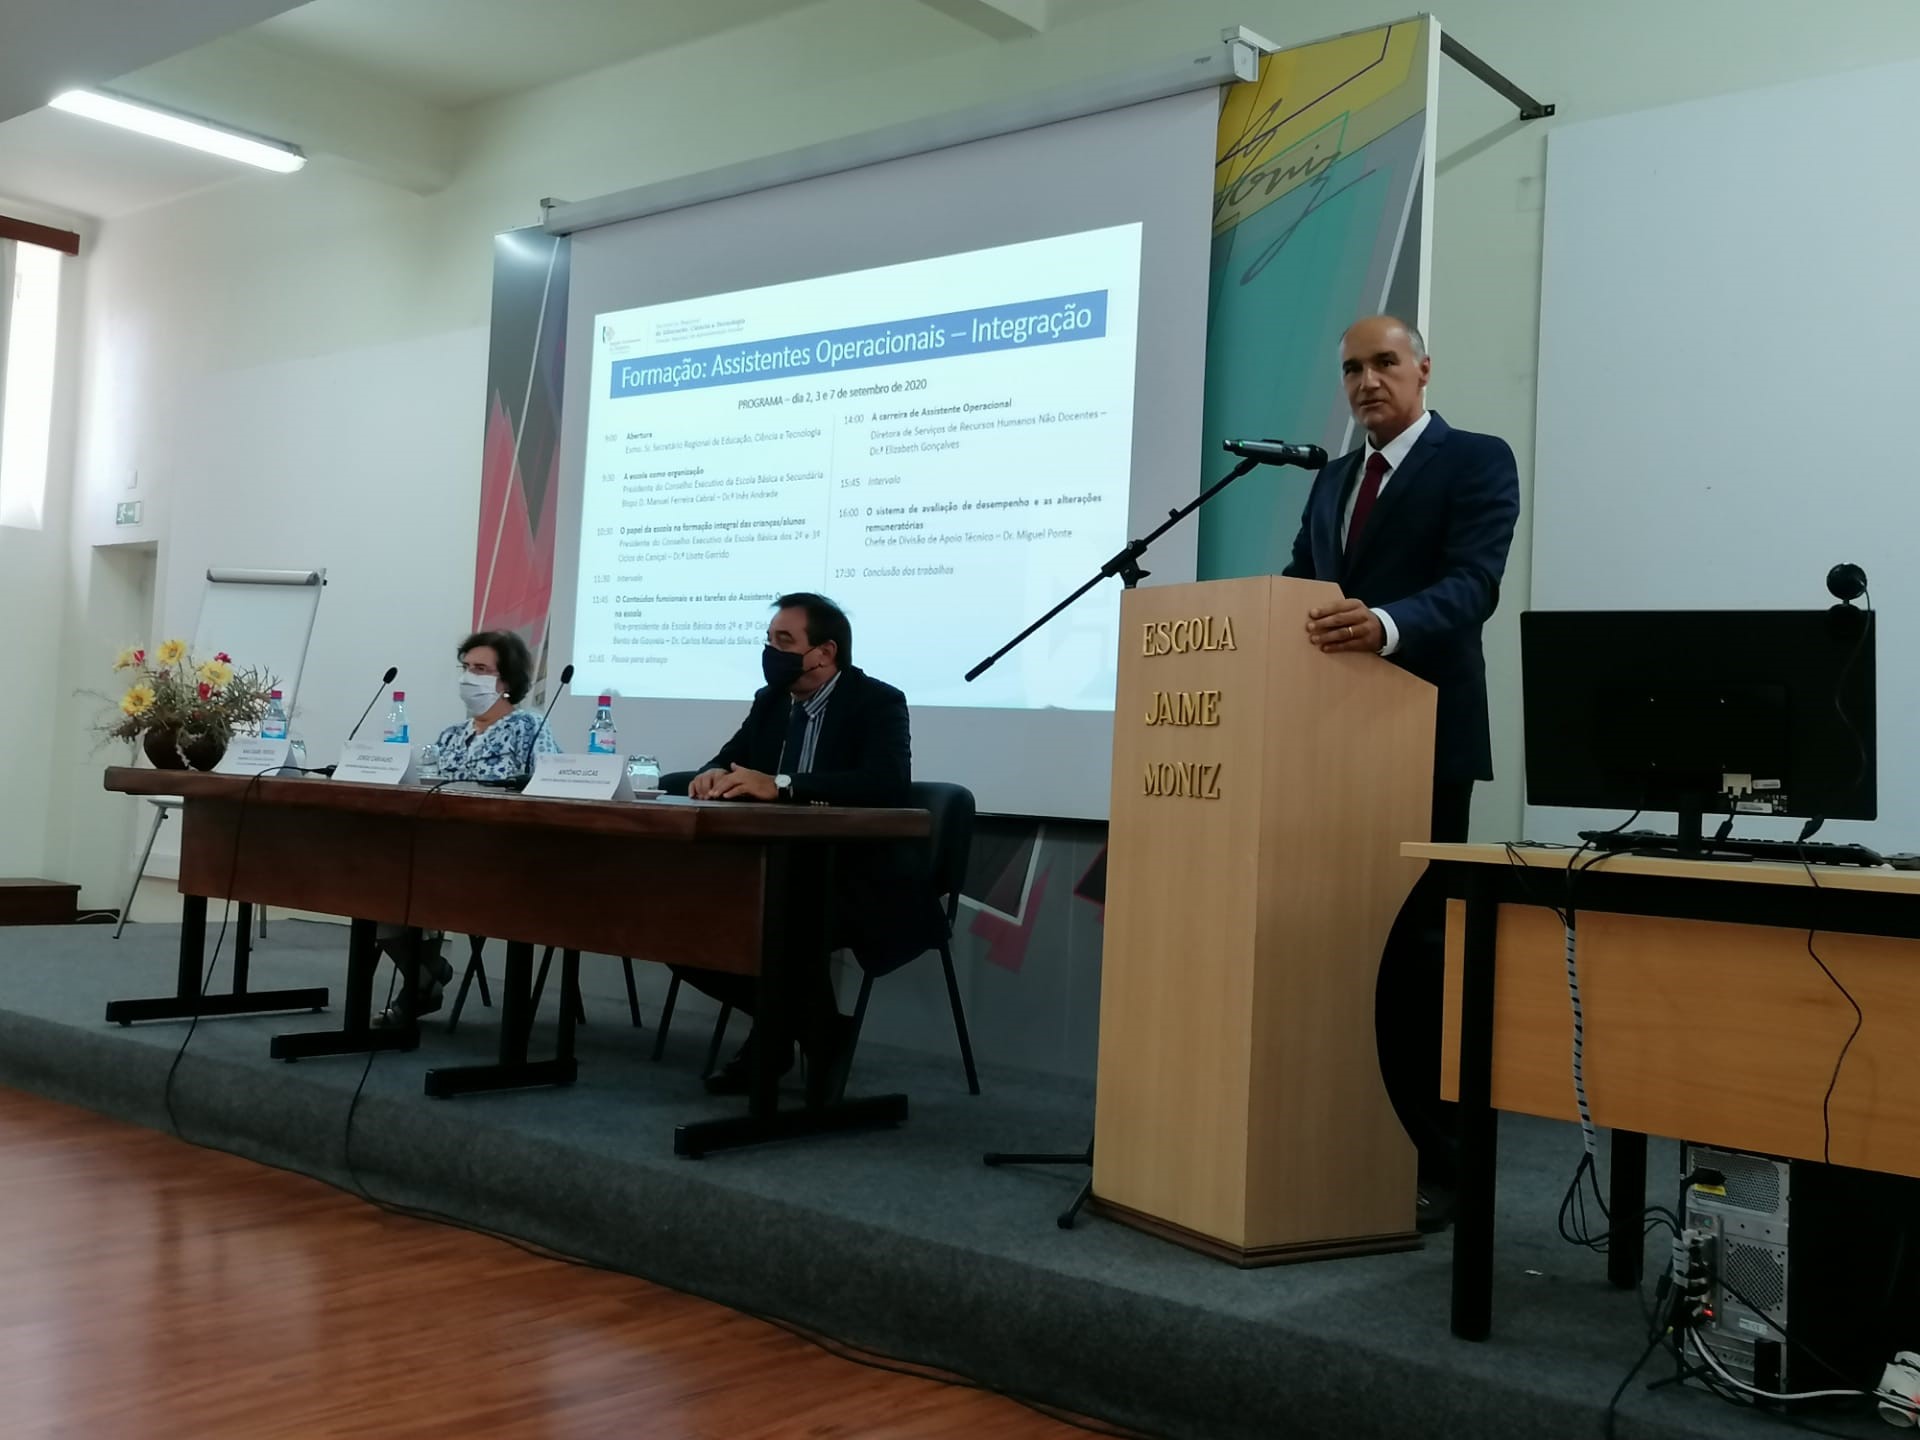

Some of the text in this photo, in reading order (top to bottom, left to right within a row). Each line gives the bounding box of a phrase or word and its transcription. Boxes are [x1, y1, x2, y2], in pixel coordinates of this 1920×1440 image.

[622, 303, 1092, 388] Formação: Assistentes Operacionais Integração
[738, 379, 928, 410] PROGRAMA dia 2, 3 e 7 de setembro de 2020
[844, 414, 864, 424] 14:00
[872, 398, 1012, 422] A carreira de Assistente Operacional
[870, 409, 1099, 440] Diretora de Serviços de Recursos Humanos Não Docentes
[626, 431, 653, 440] Abertura
[653, 441, 682, 452] Secretário
[684, 439, 711, 450] Regional
[712, 438, 720, 446] de
[755, 431, 778, 442] Ciência
[786, 427, 822, 440] Tecnologia
[885, 442, 919, 455] Elizabeth
[921, 440, 960, 453] Gonçalves
[623, 484, 654, 494] Presidente
[655, 483, 663, 491] do
[665, 480, 694, 490] Conselho
[695, 479, 724, 489] Executivo
[726, 478, 734, 486] da
[736, 476, 756, 486] Escola
[758, 474, 778, 485] Básica
[786, 470, 824, 482] Secundária
[630, 471, 648, 480] escola
[649, 471, 666, 479] como
[667, 466, 704, 479] organização
[868, 475, 901, 486] Intervalo
[841, 478, 860, 488] 15:45
[839, 508, 859, 518] 16:00
[866, 506, 872, 516] O
[876, 505, 904, 516] sistema
[908, 504, 918, 514] de
[922, 500, 958, 514] avaliação
[962, 501, 972, 510] de
[976, 497, 1029, 511] desempenho
[1057, 492, 1102, 504] alterações
[620, 527, 626, 535] O
[626, 525, 643, 536] papel
[644, 526, 651, 534] da
[653, 524, 672, 534] escola
[682, 521, 712, 532] formação
[714, 520, 738, 532] integral
[740, 520, 752, 528] das
[753, 516, 806, 530] crianças/alunos
[866, 520, 924, 532] remuneratórias
[864, 528, 1072, 546] Chefe de Divisão de Apoio Técnico Dr. Miguel Ponte
[835, 568, 856, 578] 17:30
[863, 564, 954, 578] Conclusão dos trabalhos
[1142, 616, 1237, 657] ESCOLA
[1145, 690, 1221, 727] JAIME
[1143, 761, 1222, 800] MONIZ
